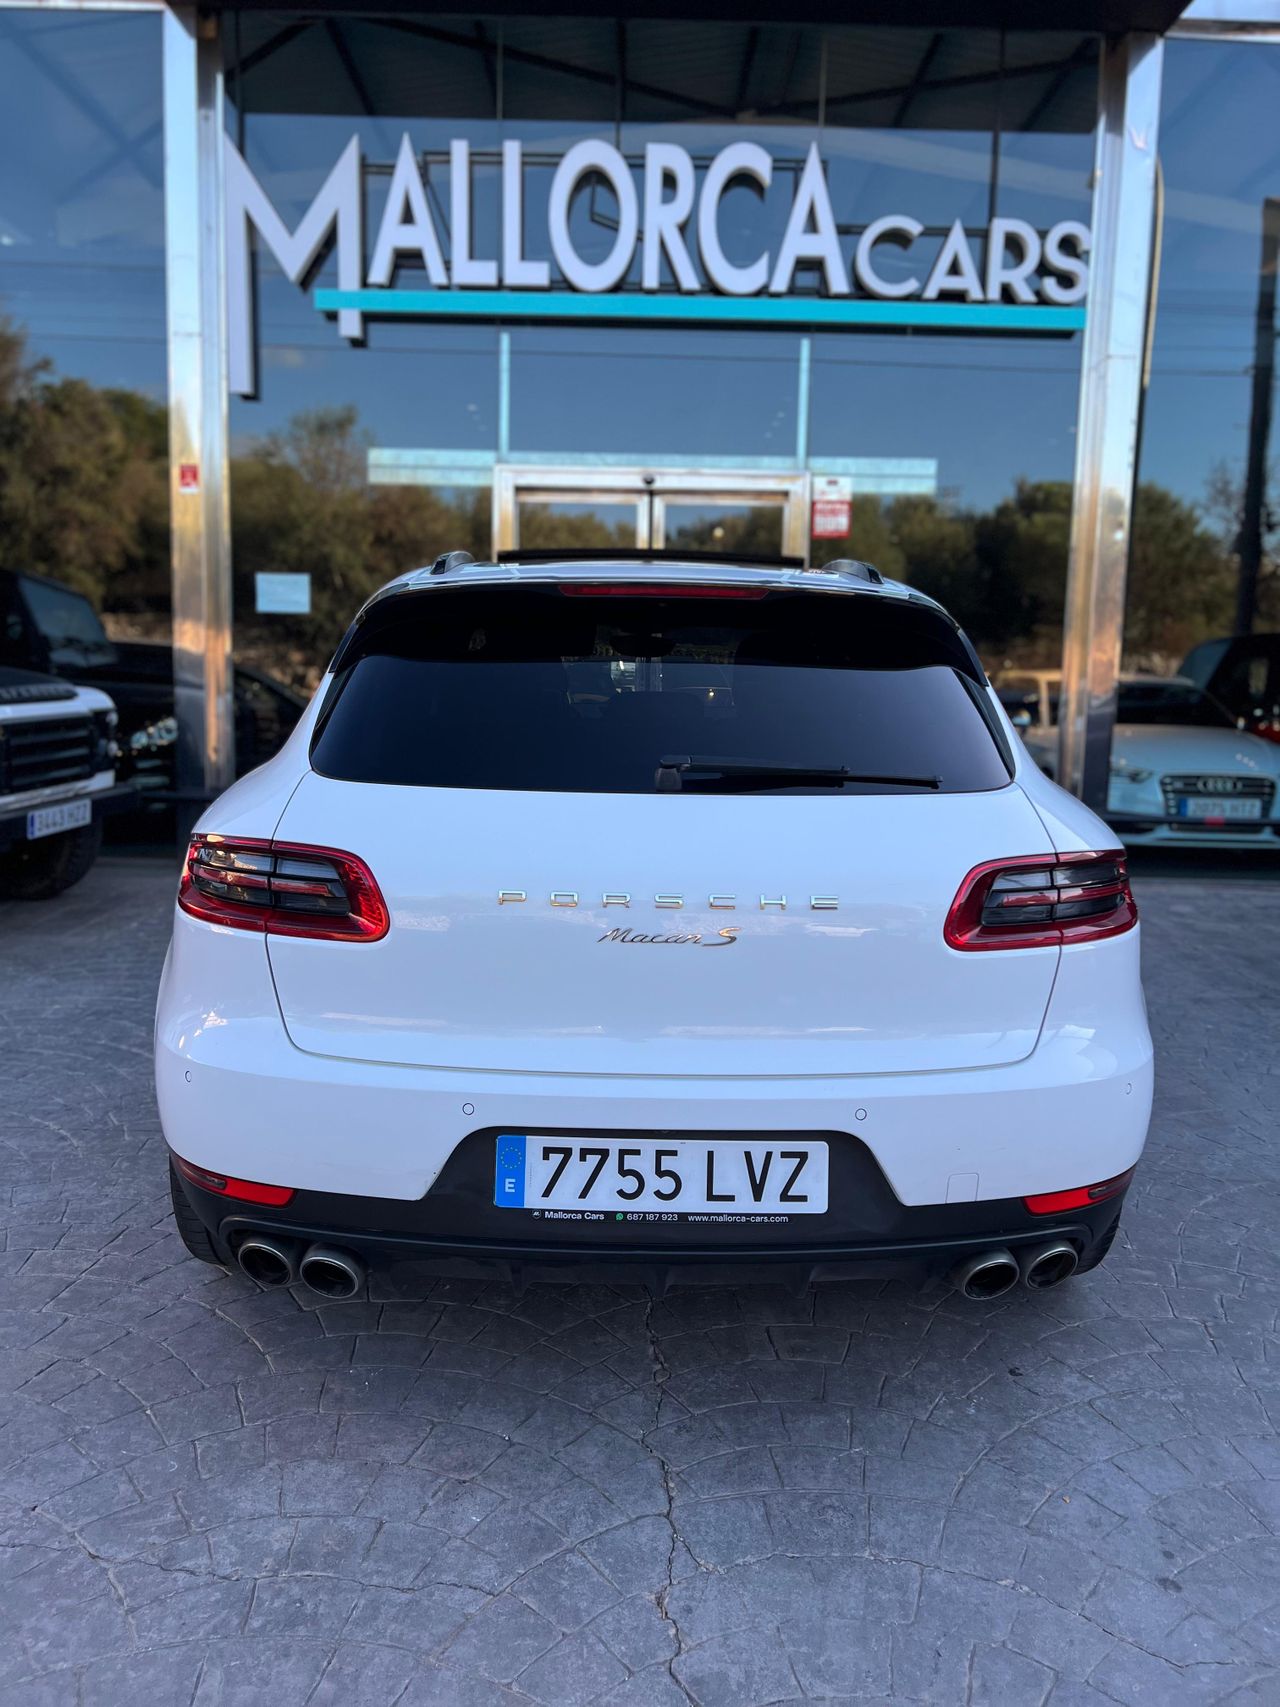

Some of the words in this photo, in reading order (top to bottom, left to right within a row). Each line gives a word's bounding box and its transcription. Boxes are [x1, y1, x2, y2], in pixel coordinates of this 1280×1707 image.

[224, 132, 852, 396] MALLORCA
[854, 214, 1092, 306] CARS
[498, 890, 839, 910] PORSCHE
[597, 926, 702, 944] Macan
[702, 926, 742, 947] S
[541, 1146, 683, 1201] 7755
[706, 1150, 809, 1203] LVZ
[504, 1178, 516, 1193] E
[544, 1211, 582, 1220] Mallorca
[584, 1212, 605, 1220] Cars
[626, 1213, 644, 1221] 687
[645, 1213, 660, 1221] 187
[661, 1213, 678, 1221] 923
[687, 1213, 789, 1223] www.mallorca-cars.com
